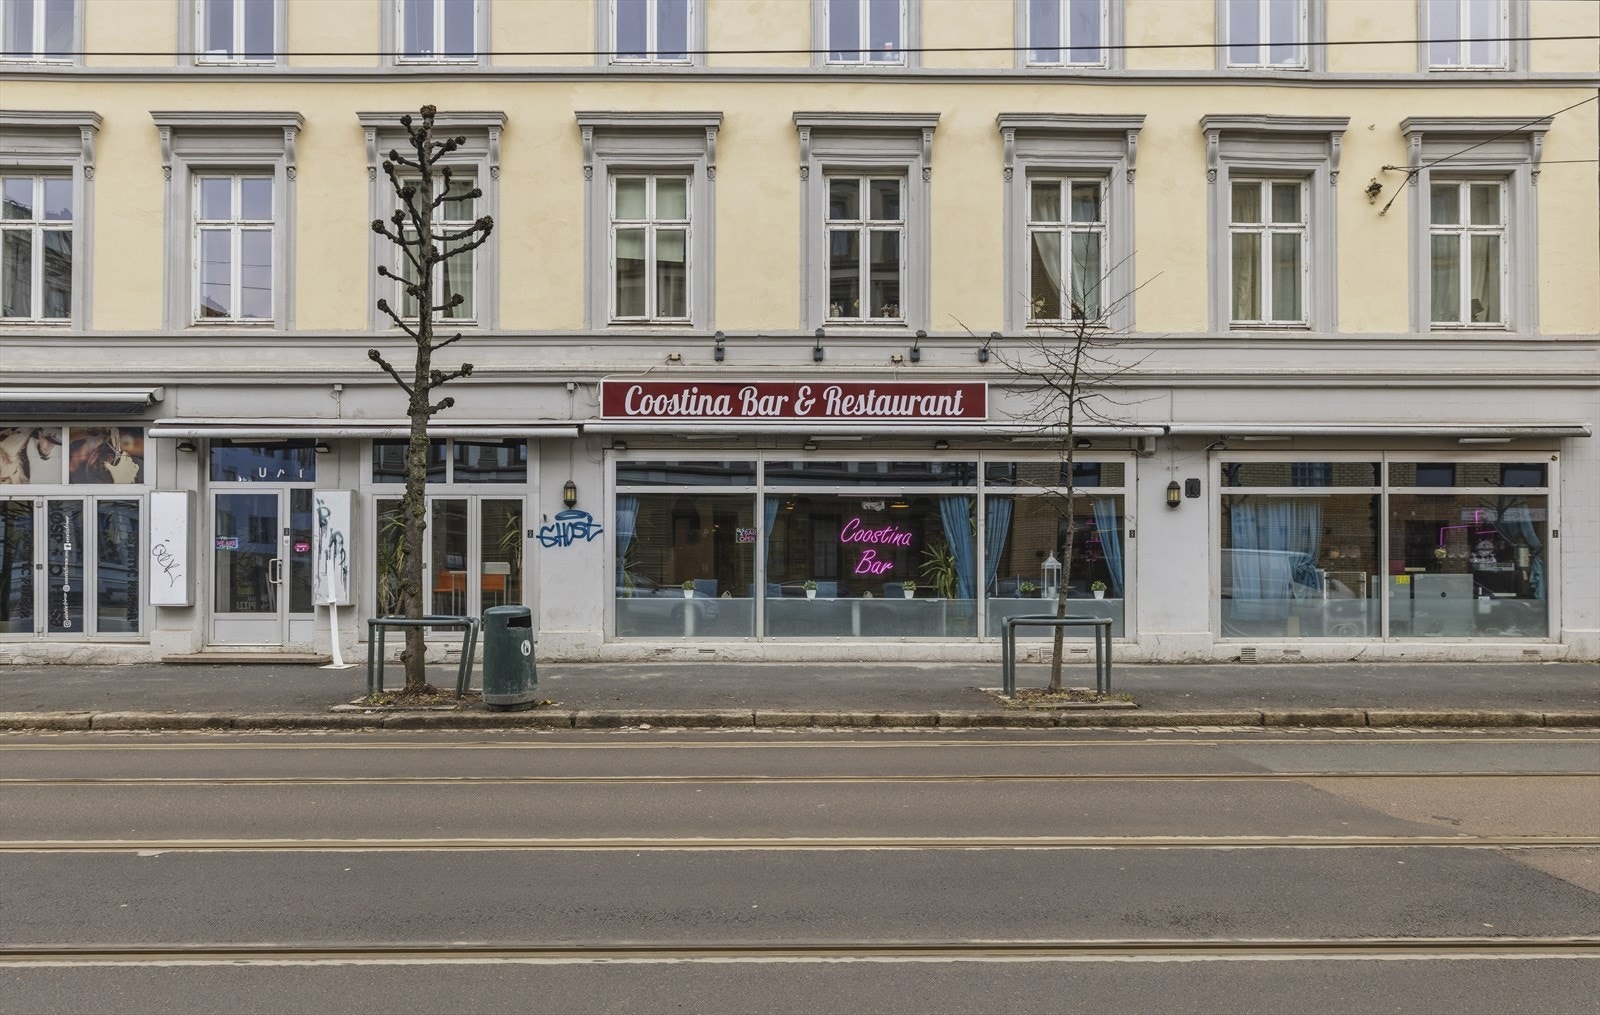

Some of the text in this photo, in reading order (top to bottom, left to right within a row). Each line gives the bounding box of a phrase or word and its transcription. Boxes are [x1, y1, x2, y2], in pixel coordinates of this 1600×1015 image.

[624, 385, 964, 416] Coostina Bar & Restaurant
[841, 518, 912, 546] Coostina
[855, 549, 893, 574] Bar
